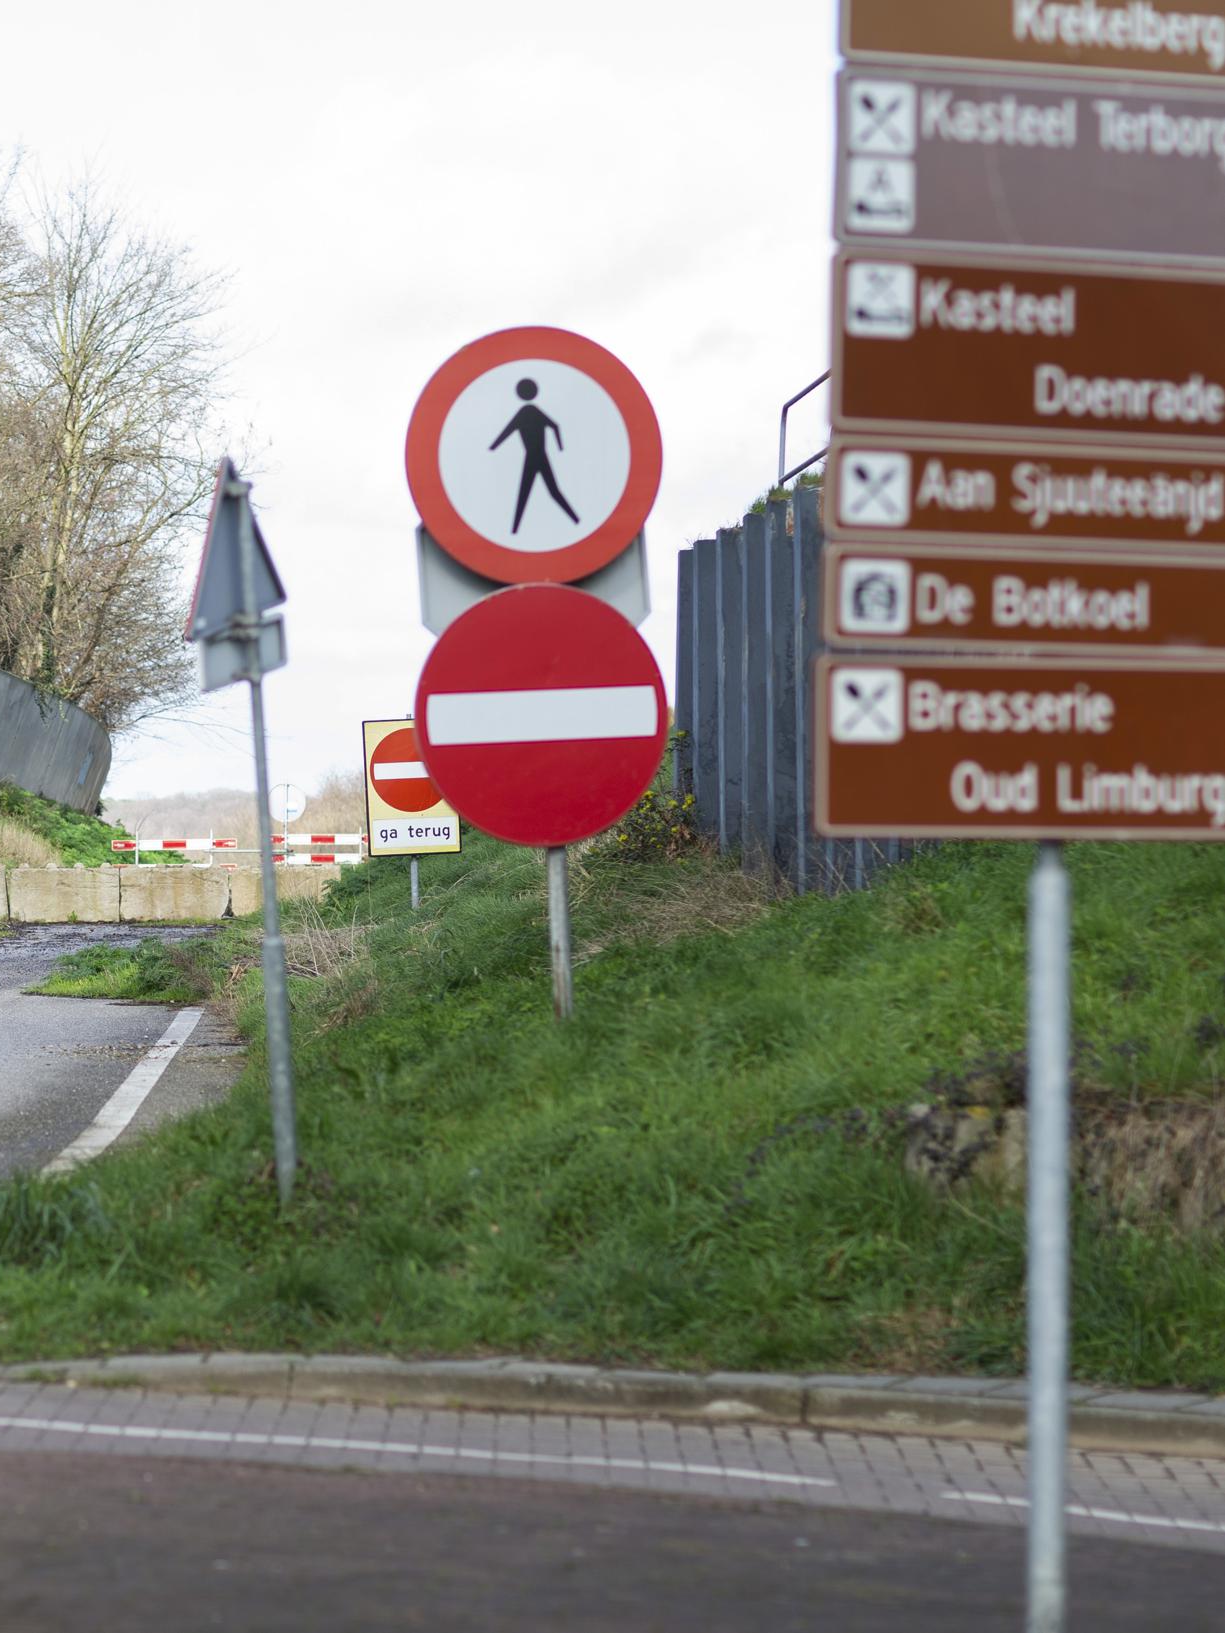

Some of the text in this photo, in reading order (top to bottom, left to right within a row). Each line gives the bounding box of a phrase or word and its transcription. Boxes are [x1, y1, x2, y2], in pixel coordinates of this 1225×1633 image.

[1012, 0, 1225, 69] Krekelberg
[921, 90, 1076, 146] Kasteel
[920, 279, 1075, 335] Kasteel
[1034, 365, 1224, 423] Doenrade
[917, 460, 995, 509] Aan
[915, 573, 1149, 630] De Botkoel
[908, 681, 1114, 732] Brasserie
[951, 761, 1225, 827] Oud Limburg
[380, 825, 451, 842] ga terug
